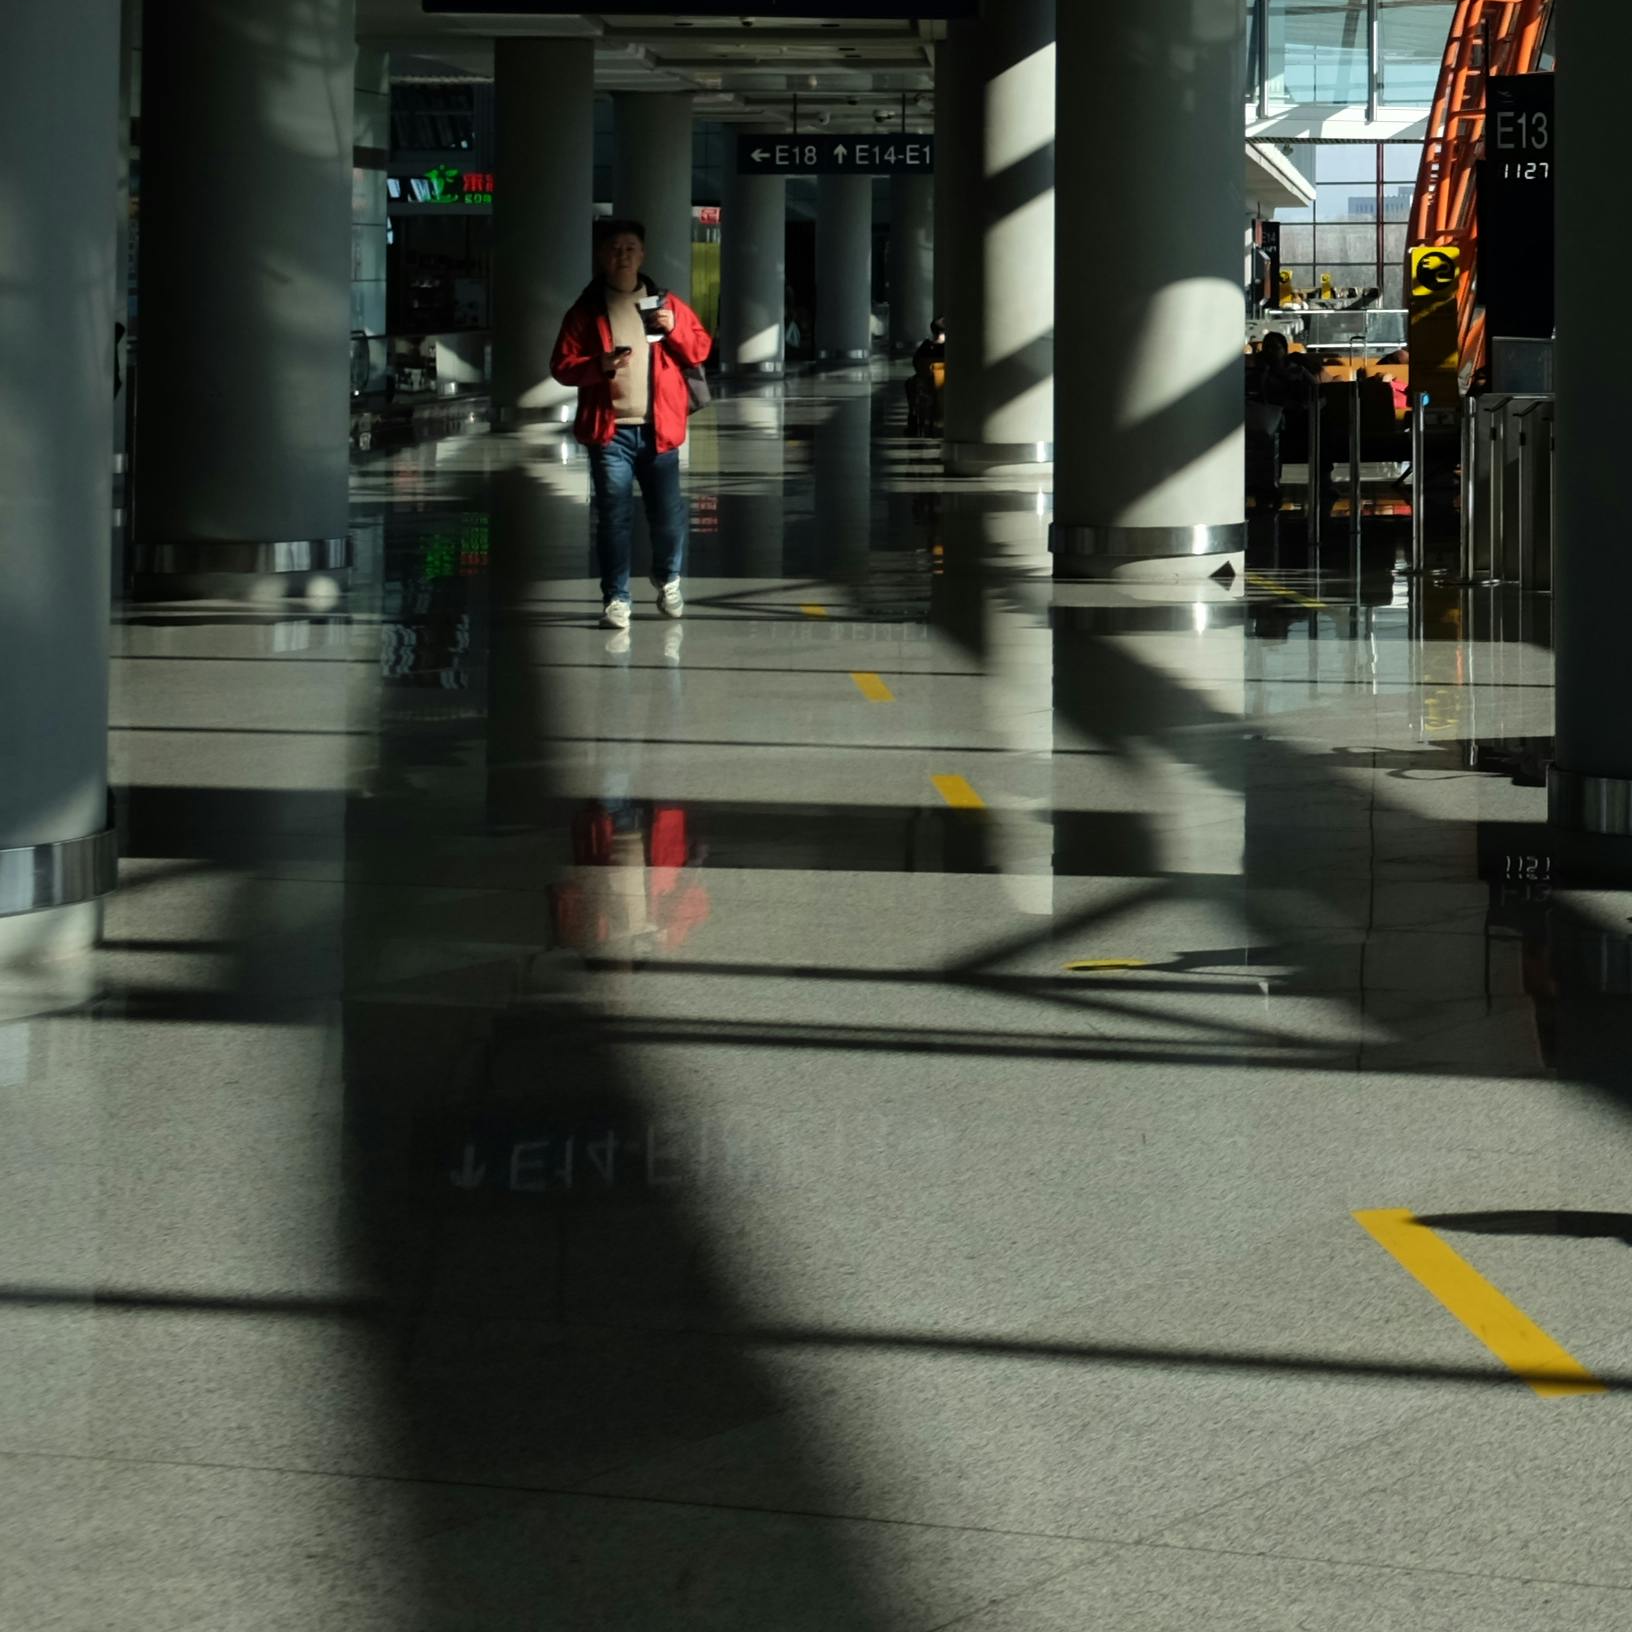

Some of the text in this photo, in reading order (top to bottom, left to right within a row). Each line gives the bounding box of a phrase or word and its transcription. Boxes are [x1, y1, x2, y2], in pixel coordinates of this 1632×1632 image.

[1496, 111, 1548, 150] E13
[774, 144, 931, 166] E18 E14-E1
